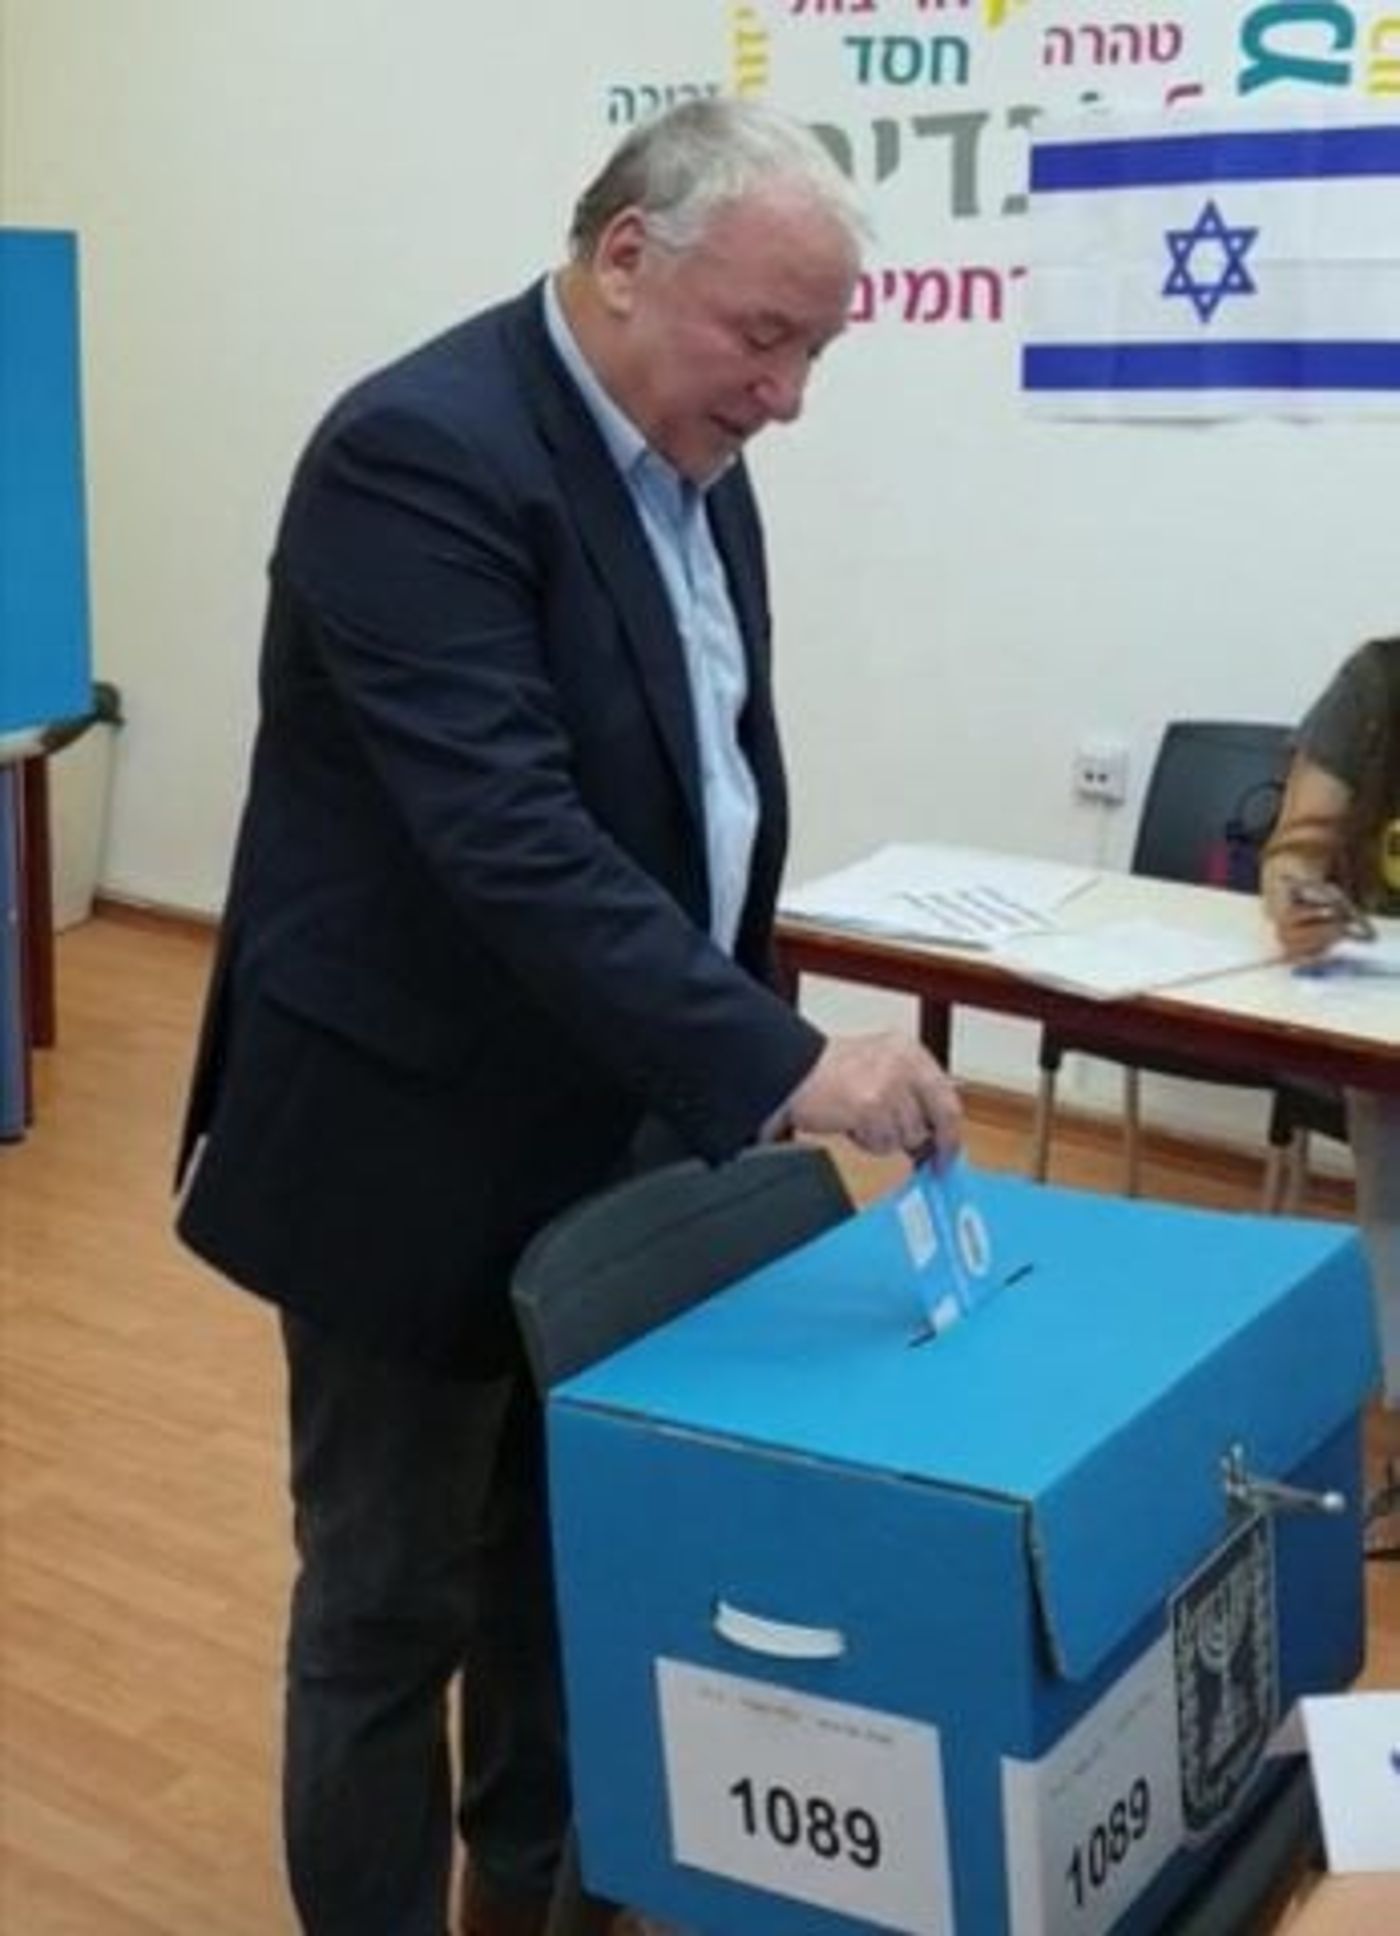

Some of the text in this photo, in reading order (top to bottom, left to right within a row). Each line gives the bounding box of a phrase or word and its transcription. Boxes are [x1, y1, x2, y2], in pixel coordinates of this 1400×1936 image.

[843, 35, 970, 85] חסד
[1043, 22, 1184, 66] טהרה
[730, 1777, 881, 1870] 1089
[1066, 1776, 1149, 1906] 1089
